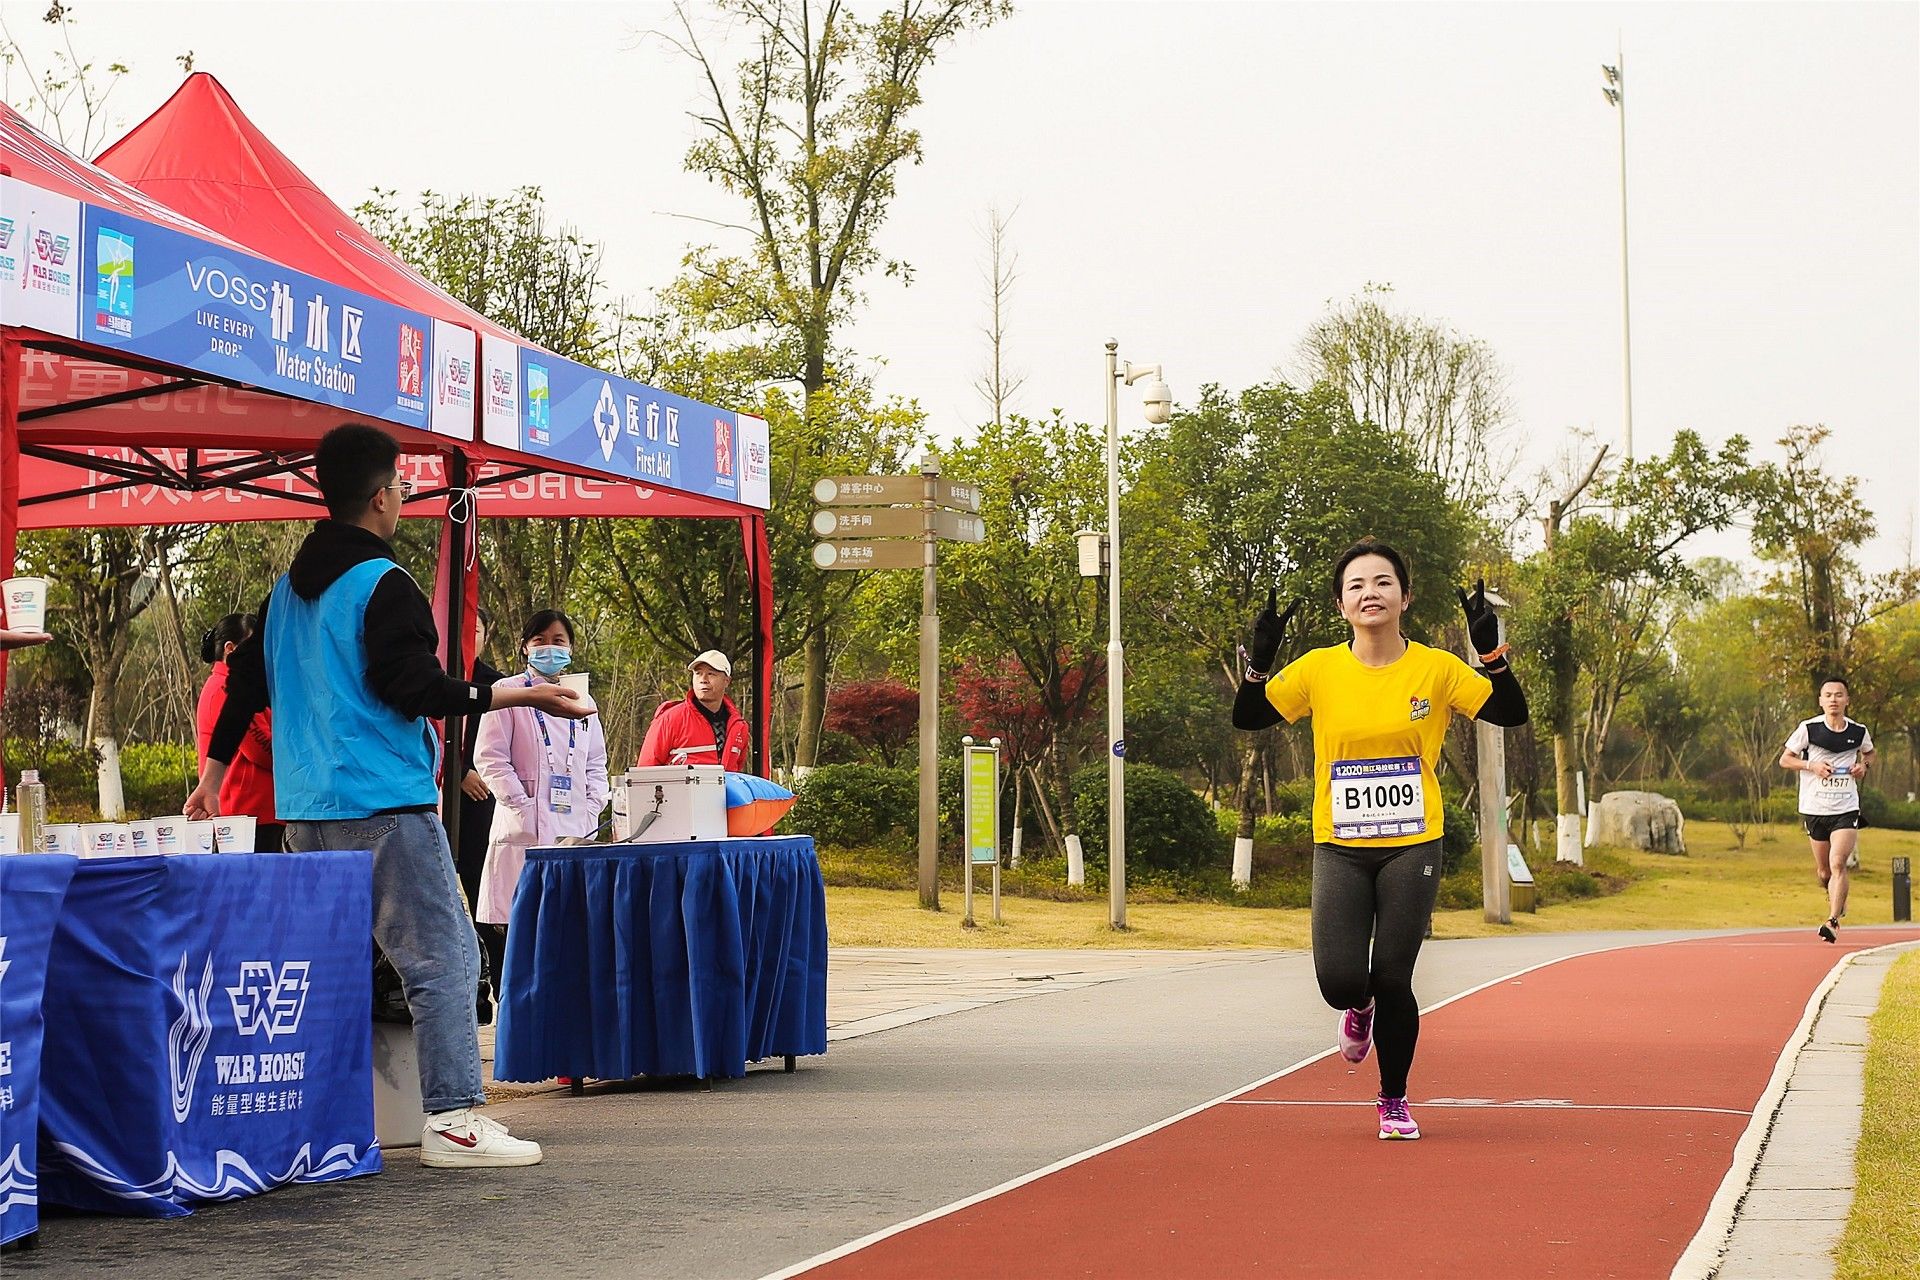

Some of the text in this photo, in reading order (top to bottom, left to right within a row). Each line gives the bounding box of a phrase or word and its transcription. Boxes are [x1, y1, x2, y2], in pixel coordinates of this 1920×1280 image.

[32, 264, 47, 279] WAR
[186, 261, 267, 311] VOSS
[197, 310, 254, 340] LIVE EVERY
[270, 280, 364, 364] 补水区
[275, 345, 312, 384] Water
[313, 356, 355, 395] Station
[626, 394, 680, 448] 医疗区
[635, 446, 671, 480] First Aid
[839, 482, 885, 494] 游客中心
[839, 514, 872, 526] 洗手间
[839, 547, 873, 559] 停车场
[1345, 783, 1414, 810] B1009
[1821, 777, 1849, 788] C1577
[214, 1051, 306, 1085] WAR HORSE
